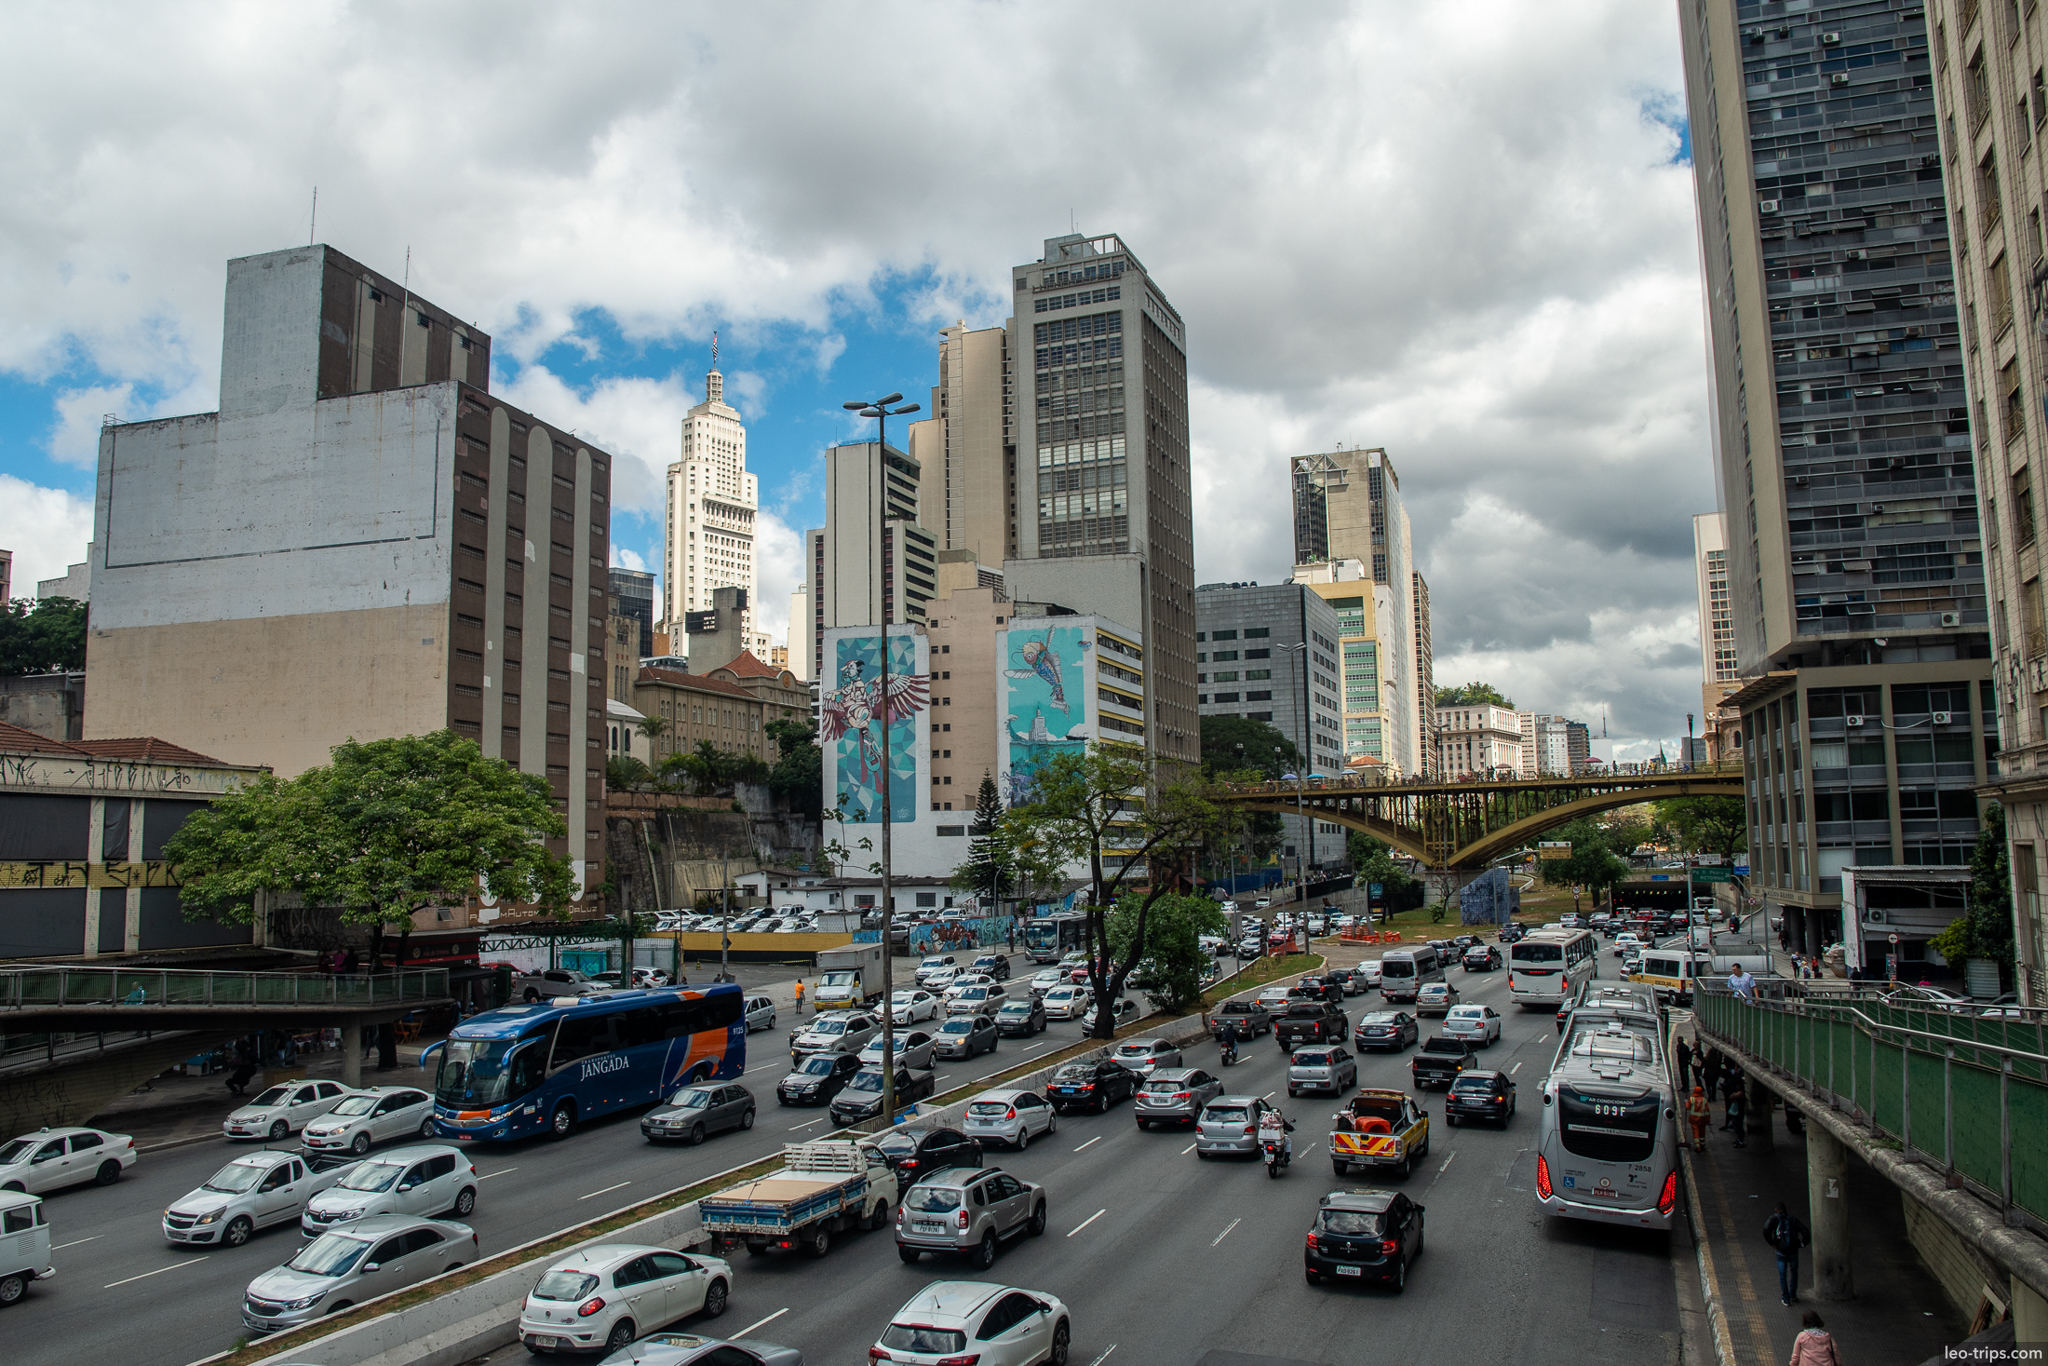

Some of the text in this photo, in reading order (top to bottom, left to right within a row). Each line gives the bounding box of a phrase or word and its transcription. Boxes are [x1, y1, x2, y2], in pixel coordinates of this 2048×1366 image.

[580, 1055, 630, 1082] JANGADA
[1596, 1097, 1635, 1106] CONDICIONADO
[1594, 1104, 1627, 1117] 609F
[1634, 1164, 1652, 1173] 2858
